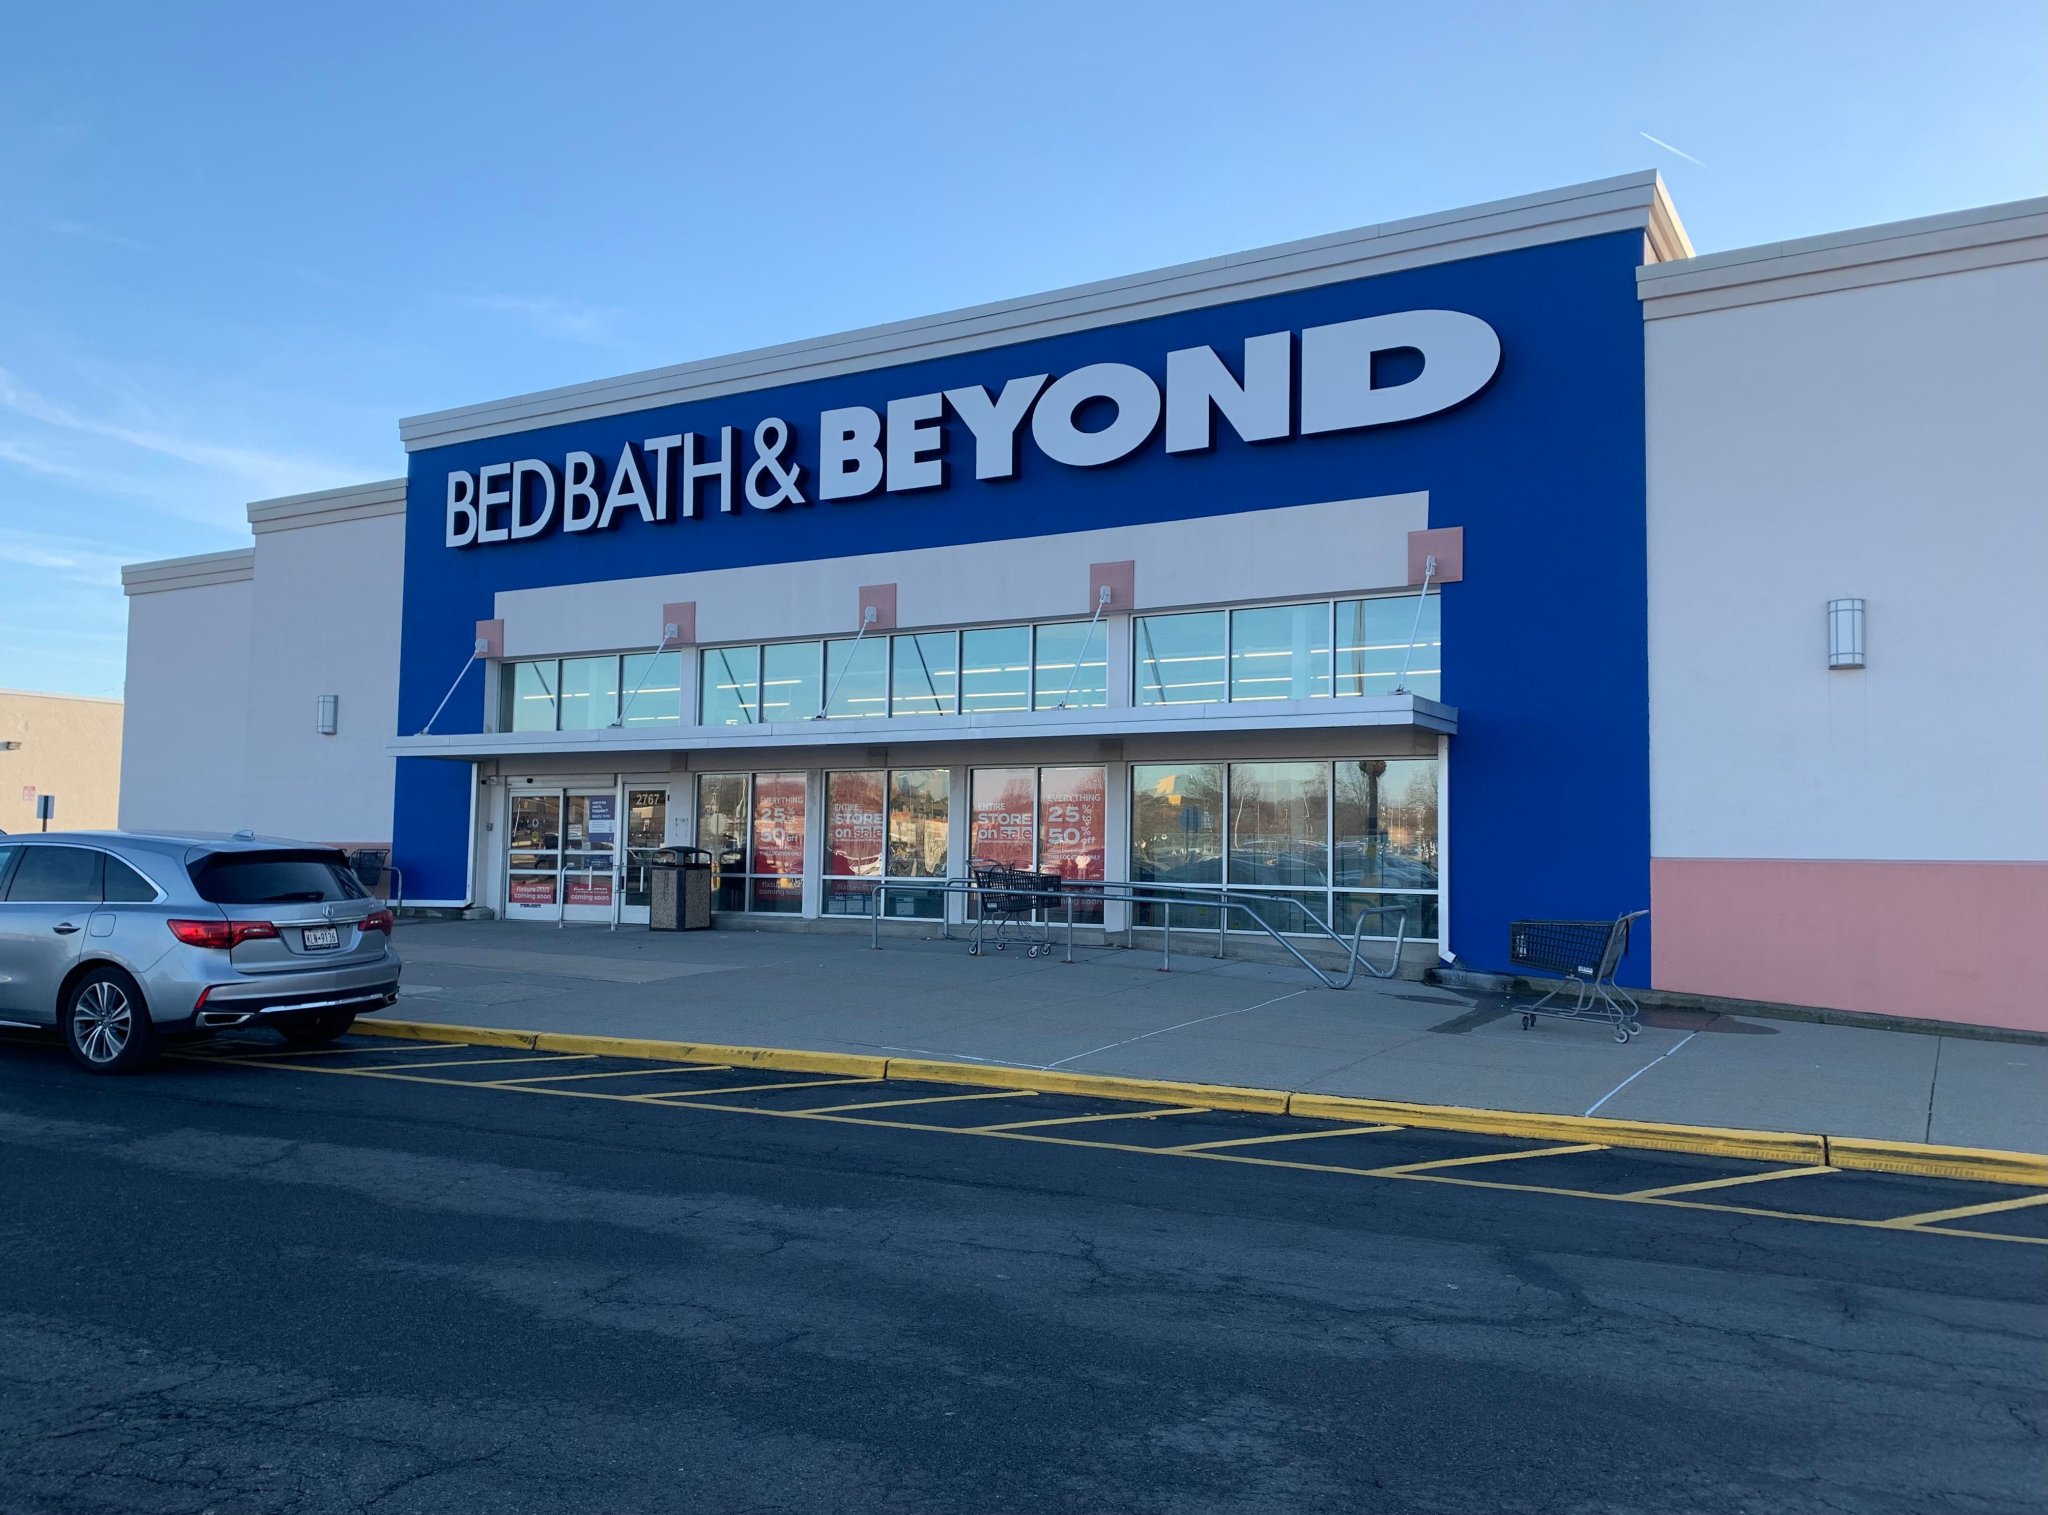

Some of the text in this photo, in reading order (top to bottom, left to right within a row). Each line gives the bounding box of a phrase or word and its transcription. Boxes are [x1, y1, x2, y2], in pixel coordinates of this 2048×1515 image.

[446, 309, 1501, 548] BED BATH & BEYOND
[636, 794, 660, 806] 2767
[760, 796, 803, 804] EVERYTHING
[1048, 794, 1101, 802] EVERYTHING
[835, 803, 860, 811] ENTIRE
[978, 802, 1006, 811] ENTIRE
[835, 813, 883, 825] STORE
[978, 812, 1032, 825] STORE
[786, 833, 799, 842] off
[835, 827, 883, 839] on sale
[978, 827, 1032, 840] on sale
[1082, 836, 1096, 844] off
[571, 894, 594, 902] coming
